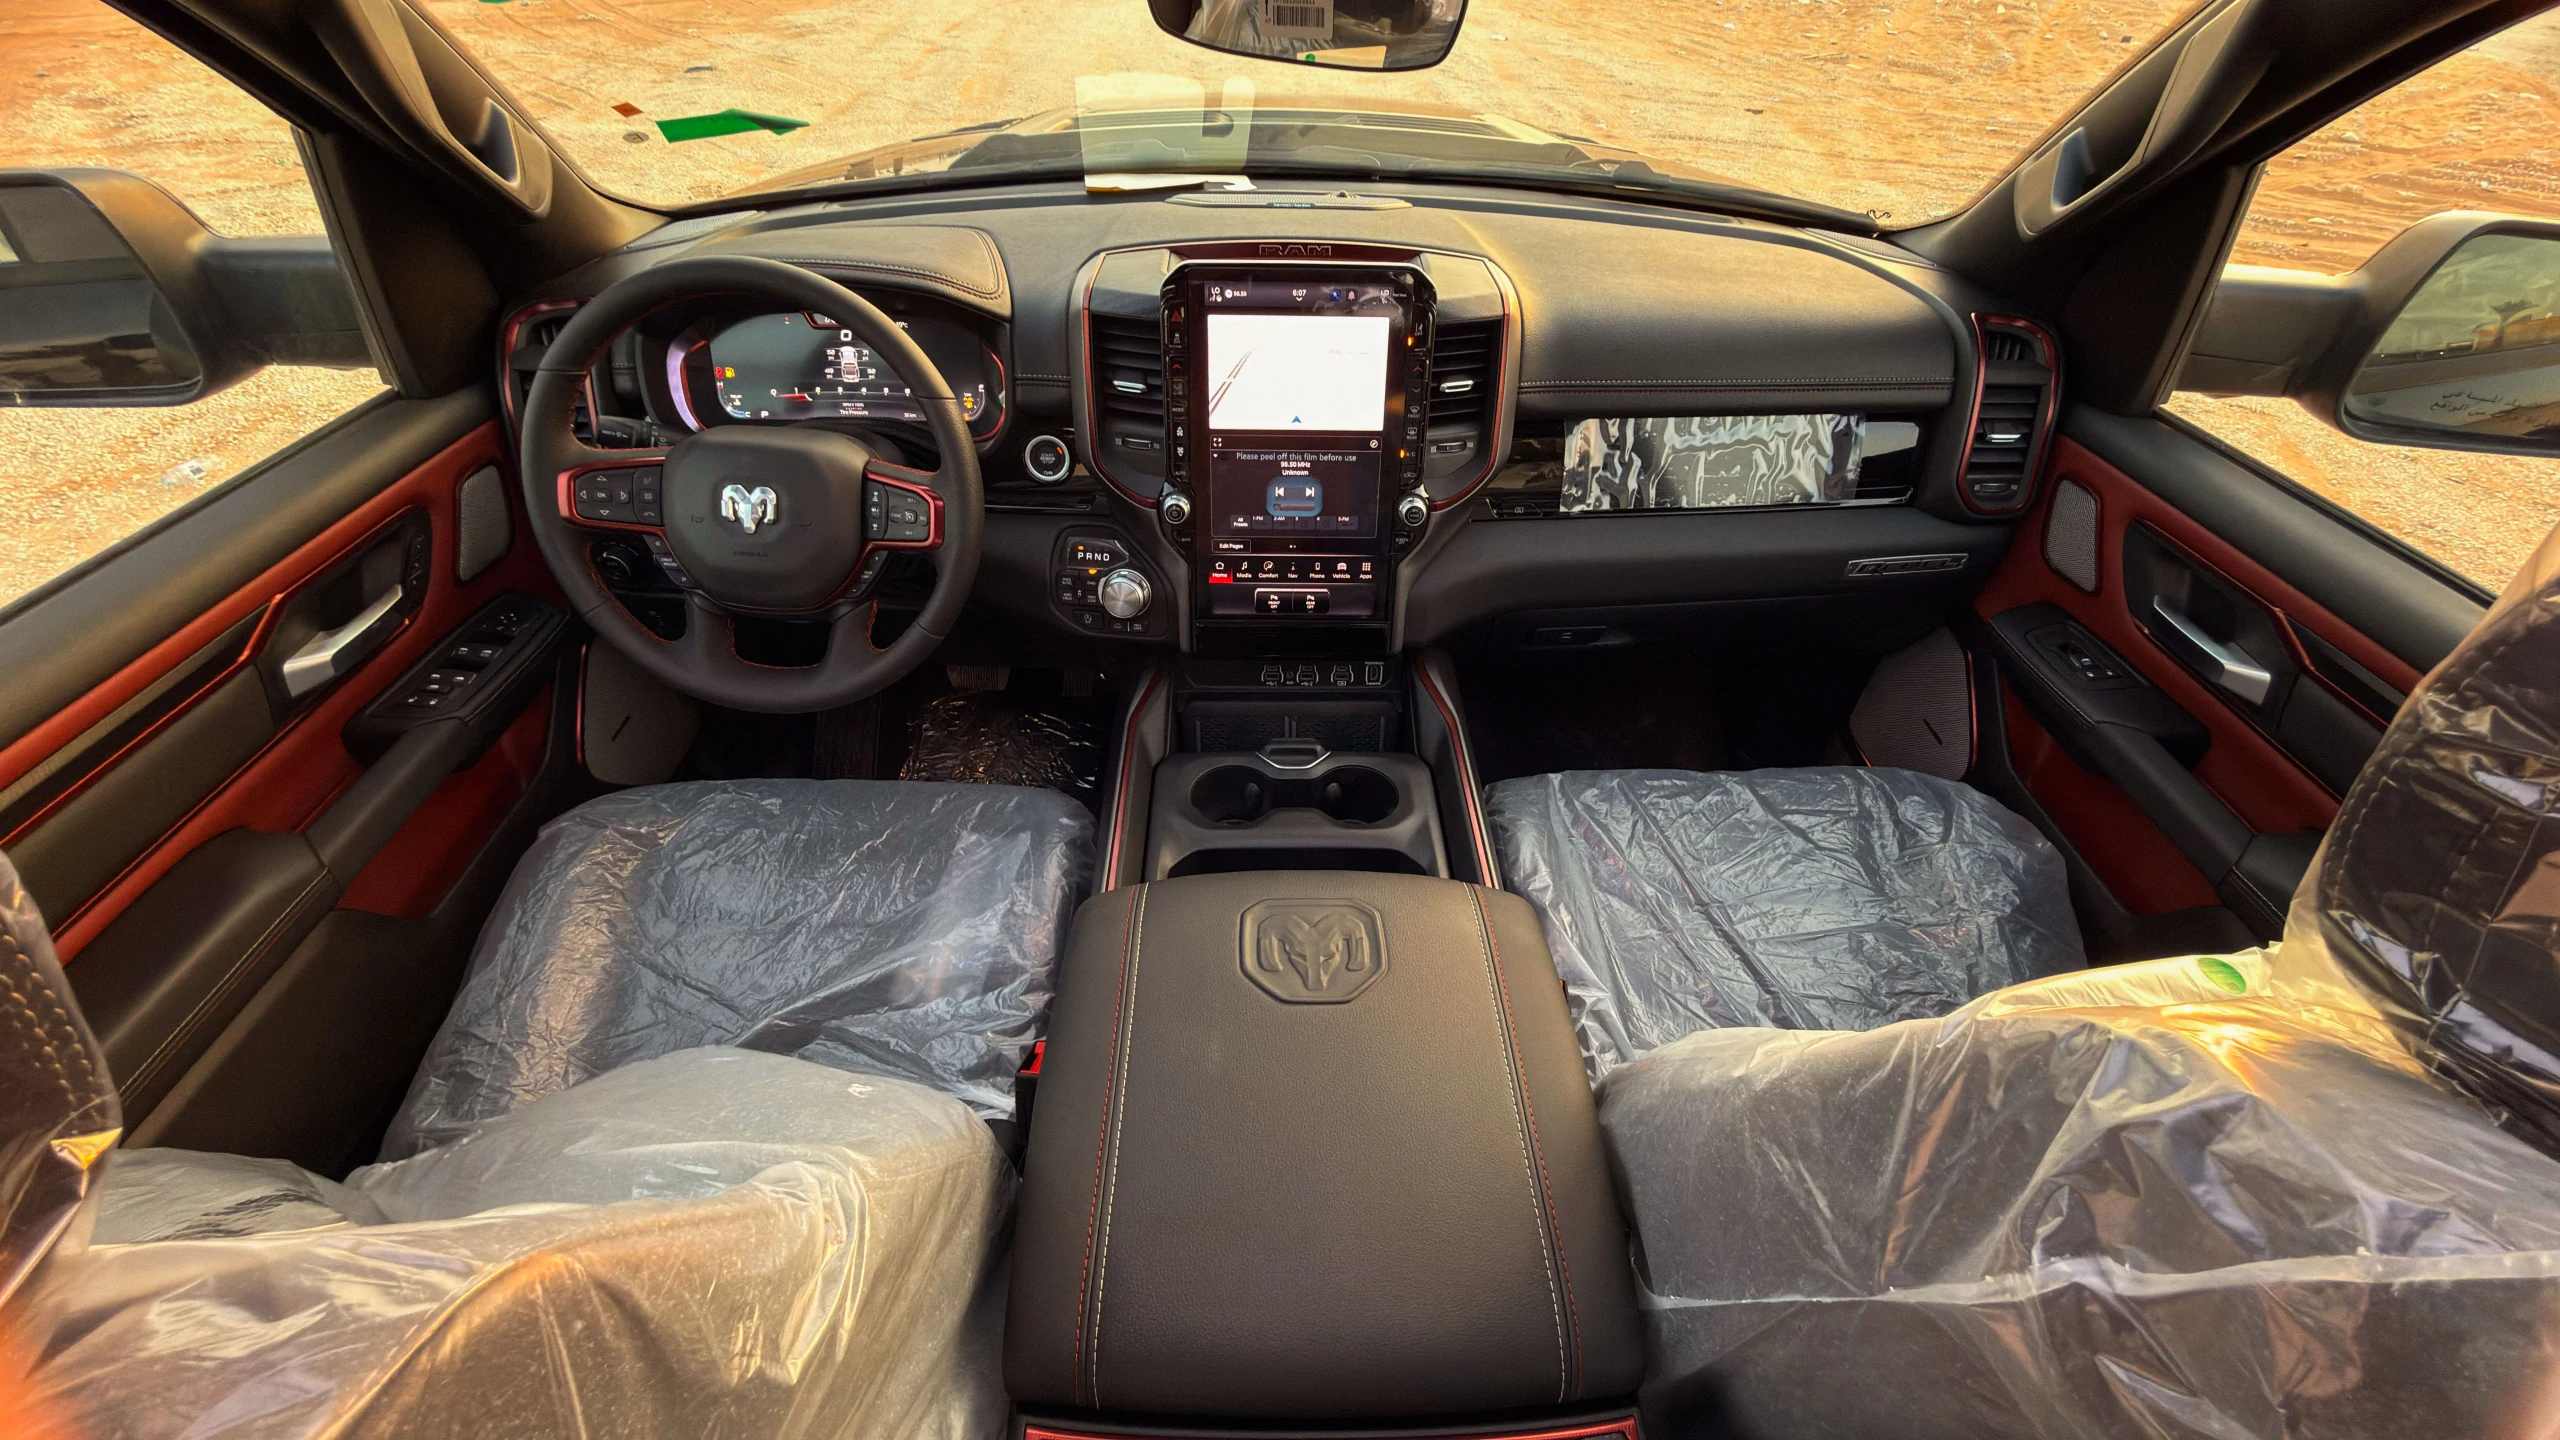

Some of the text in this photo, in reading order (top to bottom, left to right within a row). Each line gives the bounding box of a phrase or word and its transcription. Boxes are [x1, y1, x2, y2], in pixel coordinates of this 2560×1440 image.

[1259, 244, 1331, 256] RAM
[1292, 289, 1307, 297] 6:07
[1236, 452, 1259, 460] Please
[1260, 453, 1276, 462] peel
[1289, 453, 1302, 461] this
